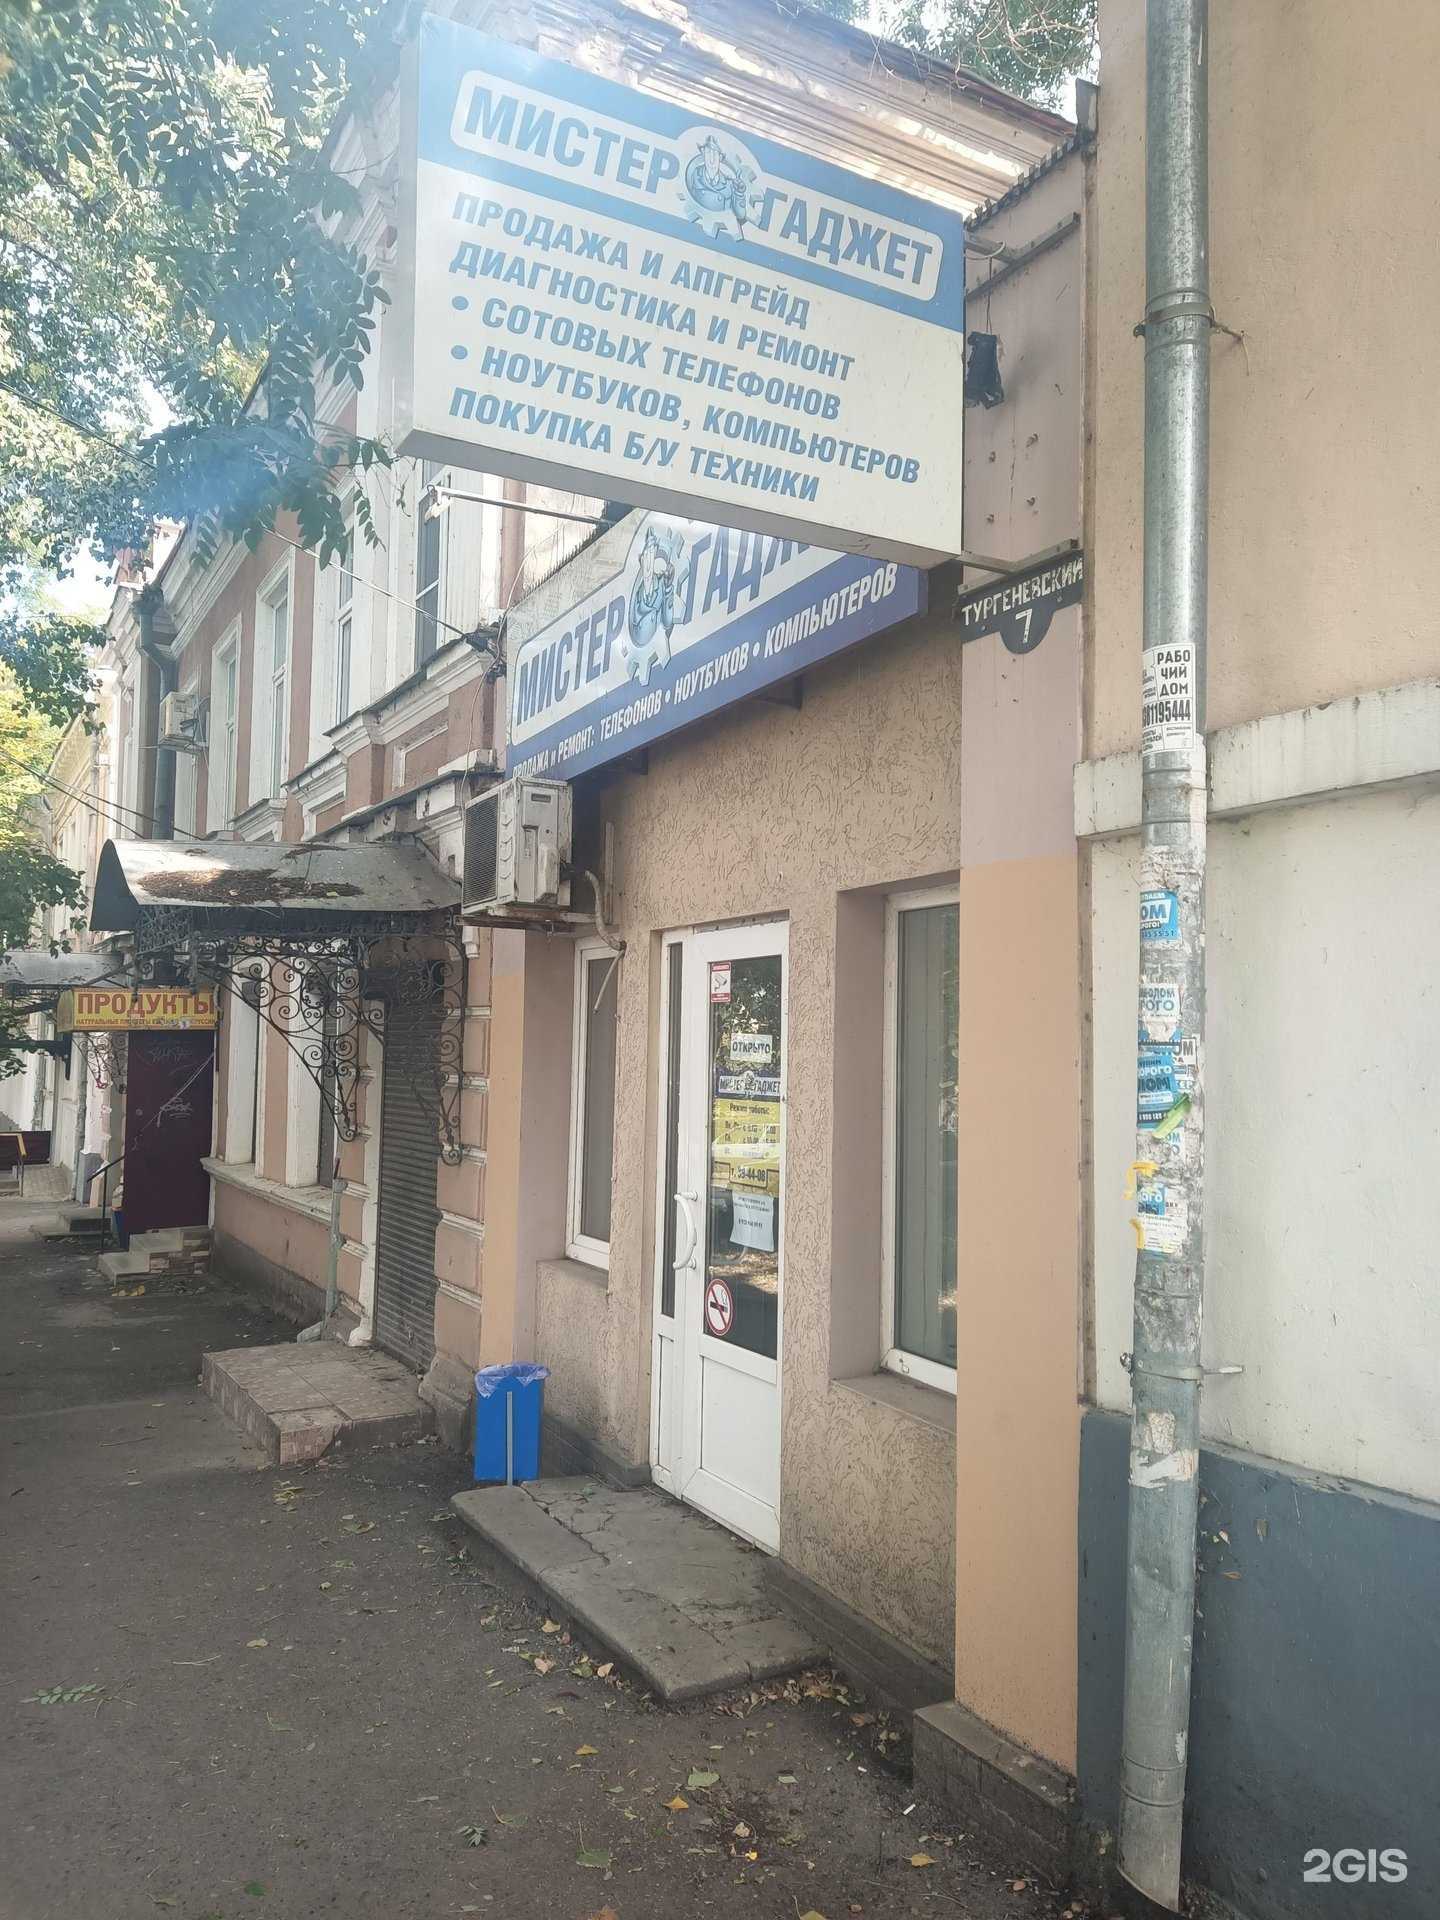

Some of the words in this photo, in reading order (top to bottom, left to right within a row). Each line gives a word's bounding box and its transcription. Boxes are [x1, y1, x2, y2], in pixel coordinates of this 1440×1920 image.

[464, 86, 681, 194] МИСТЕР
[758, 187, 933, 285] ГАДЖЕТ
[449, 242, 697, 335] ДИАГНОСТИКА
[707, 317, 728, 345] И
[737, 325, 855, 381] РЕМОНТ
[451, 191, 628, 270] ПРОДАЖА
[641, 250, 663, 279] И
[671, 261, 810, 330] АПГРЕЙД
[481, 346, 690, 430] НОУТБУКОВ,
[703, 407, 920, 484] КОМПЬЮТЕРОВ
[482, 297, 648, 367] СОТОВЫХ
[662, 346, 840, 420] ТЕЛЕФОНОВ
[449, 387, 612, 454] ПОКУПКА
[623, 432, 678, 468] Б/У
[689, 446, 820, 502] ТЕХНИКИ
[517, 594, 626, 727] МИСТЕР
[683, 526, 810, 625] ГАД
[558, 725, 595, 763] РЕМОНТ:
[600, 693, 662, 742] ТЕЛЕФОНОВ
[674, 650, 749, 704] НОУТБУКОВ
[763, 562, 898, 658] КОМПЬЮТЕРОВ
[1015, 608, 1033, 643] 7
[1157, 650, 1191, 664] РАБО
[1161, 663, 1187, 679] ЧИЙ
[1160, 682, 1188, 697] ДОМ
[78, 993, 214, 1018] ПРОДУКТЫ
[732, 1041, 770, 1054] ОТКРЫТО
